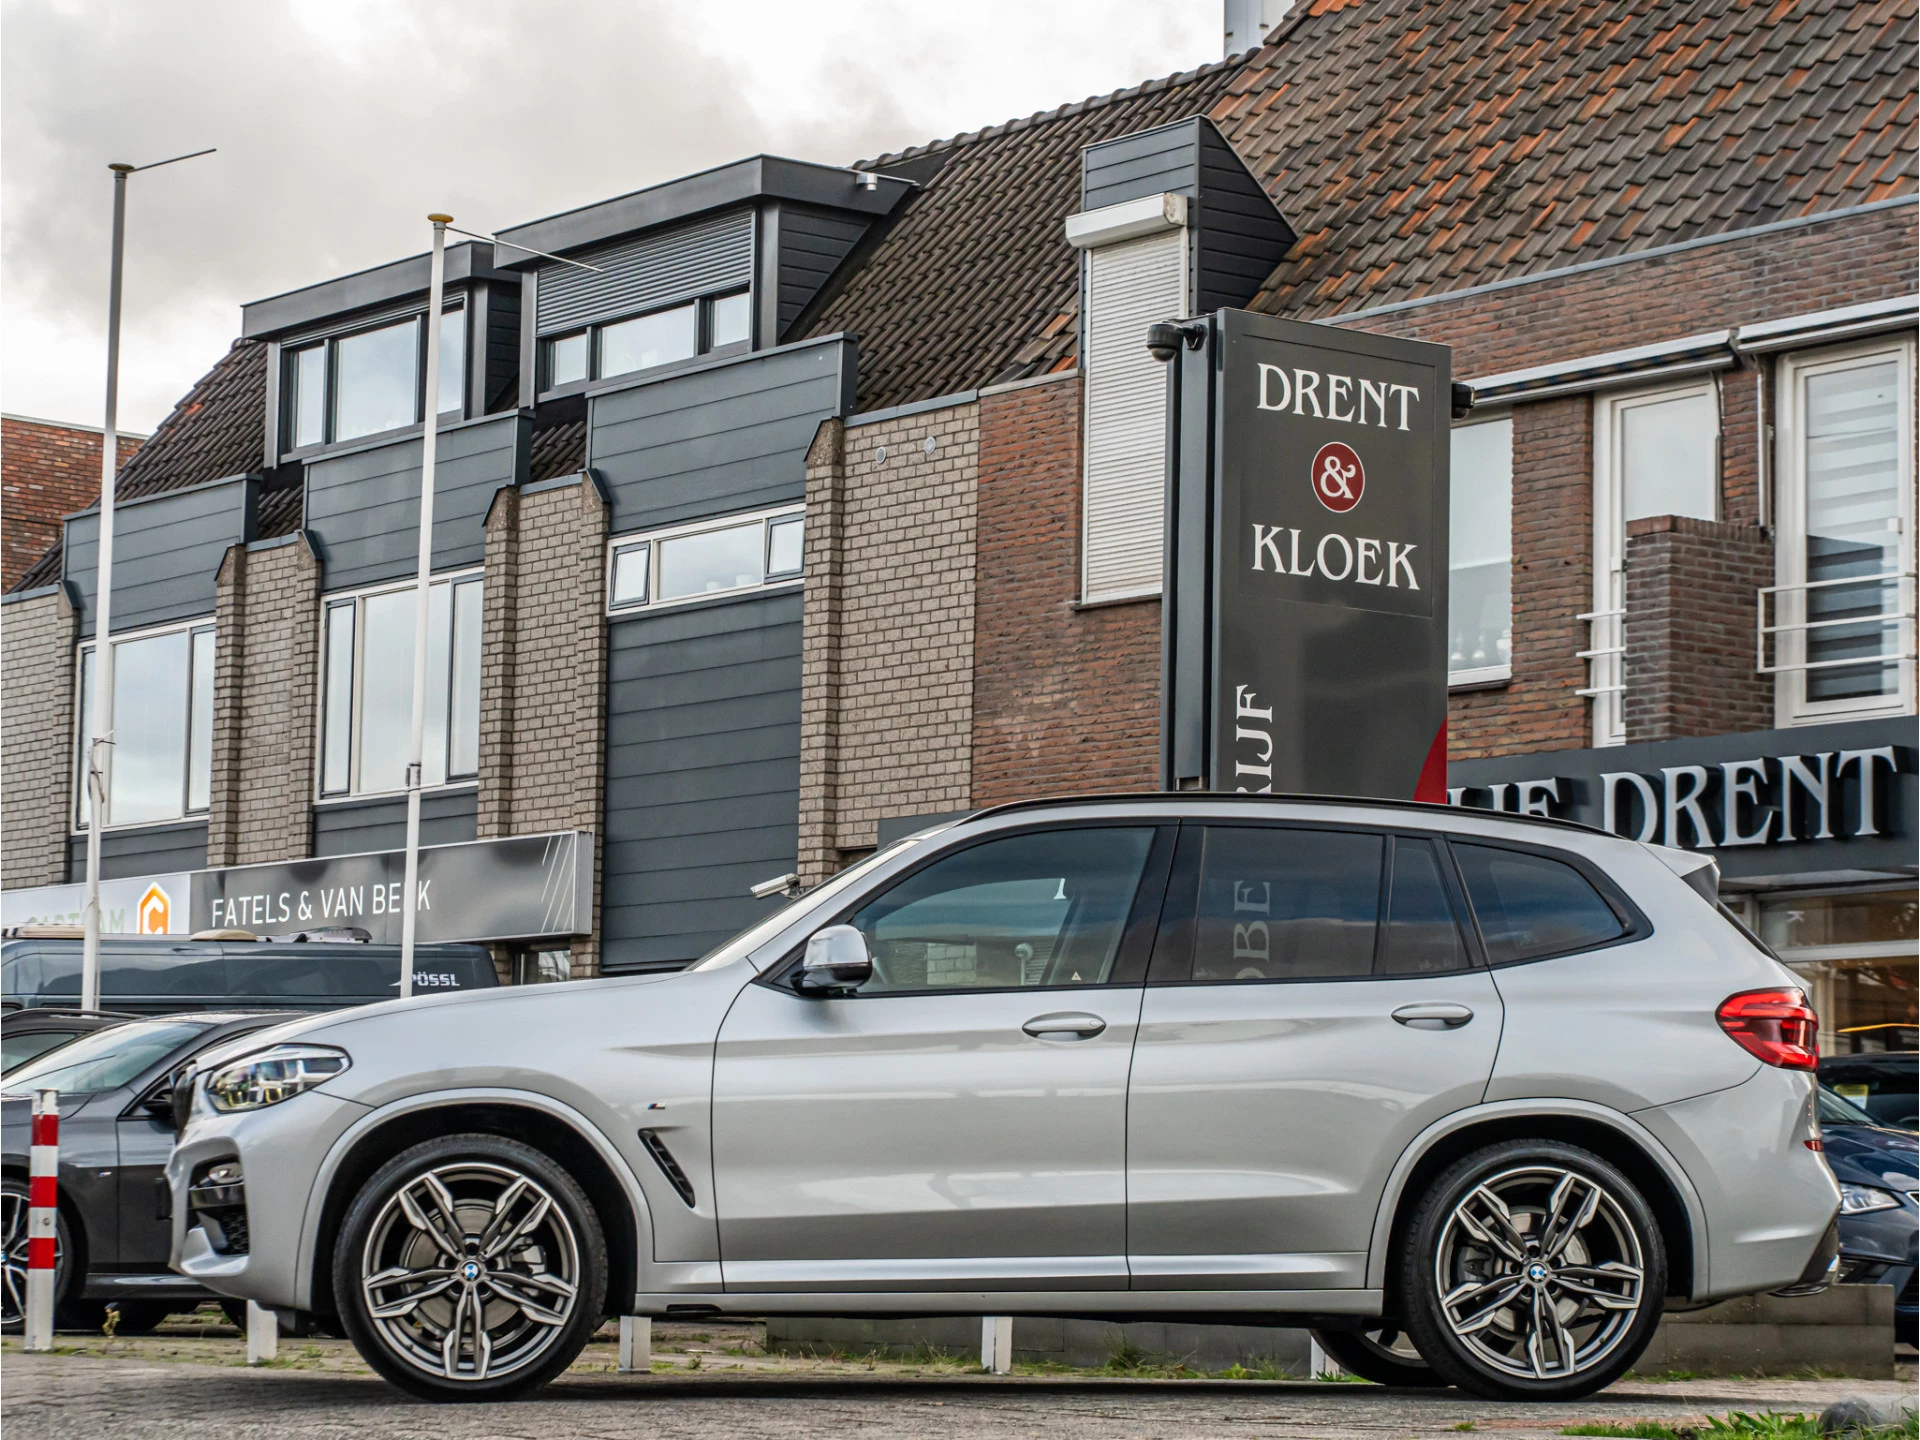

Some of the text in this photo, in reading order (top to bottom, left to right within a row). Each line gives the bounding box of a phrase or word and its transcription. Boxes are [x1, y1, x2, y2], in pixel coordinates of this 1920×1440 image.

[1256, 362, 1421, 432] DRENT
[1319, 455, 1357, 500] &
[1251, 523, 1421, 591] KLOEK
[1599, 745, 1898, 849] DRENT
[211, 878, 432, 929] FATELS & VAN BEK
[1232, 880, 1271, 979] BE
